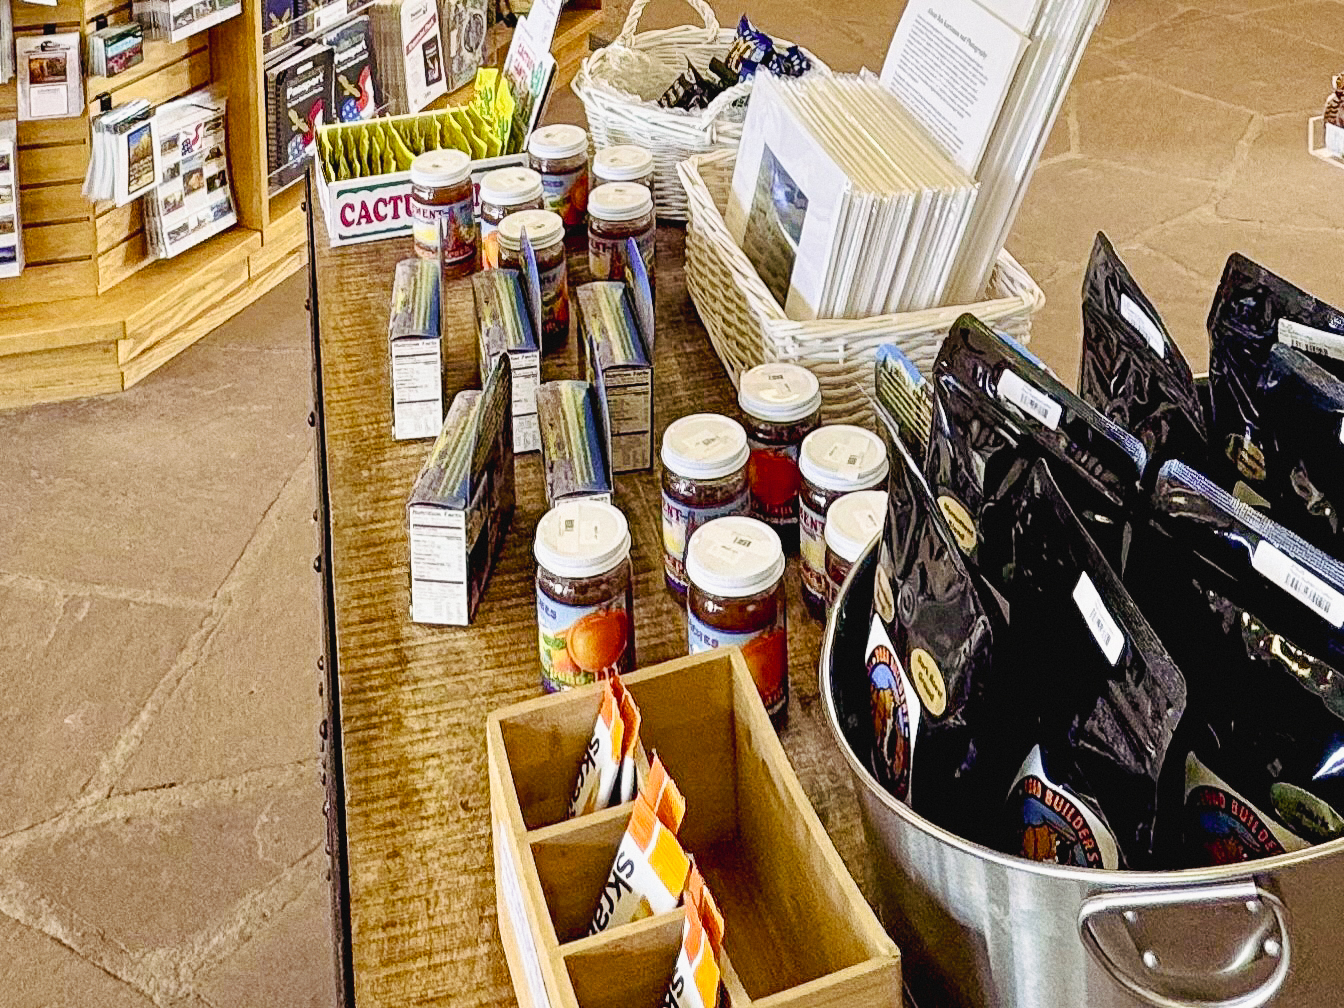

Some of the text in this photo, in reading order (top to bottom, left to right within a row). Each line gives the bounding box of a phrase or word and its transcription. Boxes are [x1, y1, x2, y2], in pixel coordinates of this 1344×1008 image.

[287, 72, 324, 100] Passport
[340, 193, 413, 228] CACTU
[1043, 788, 1101, 864] BUILDERS
